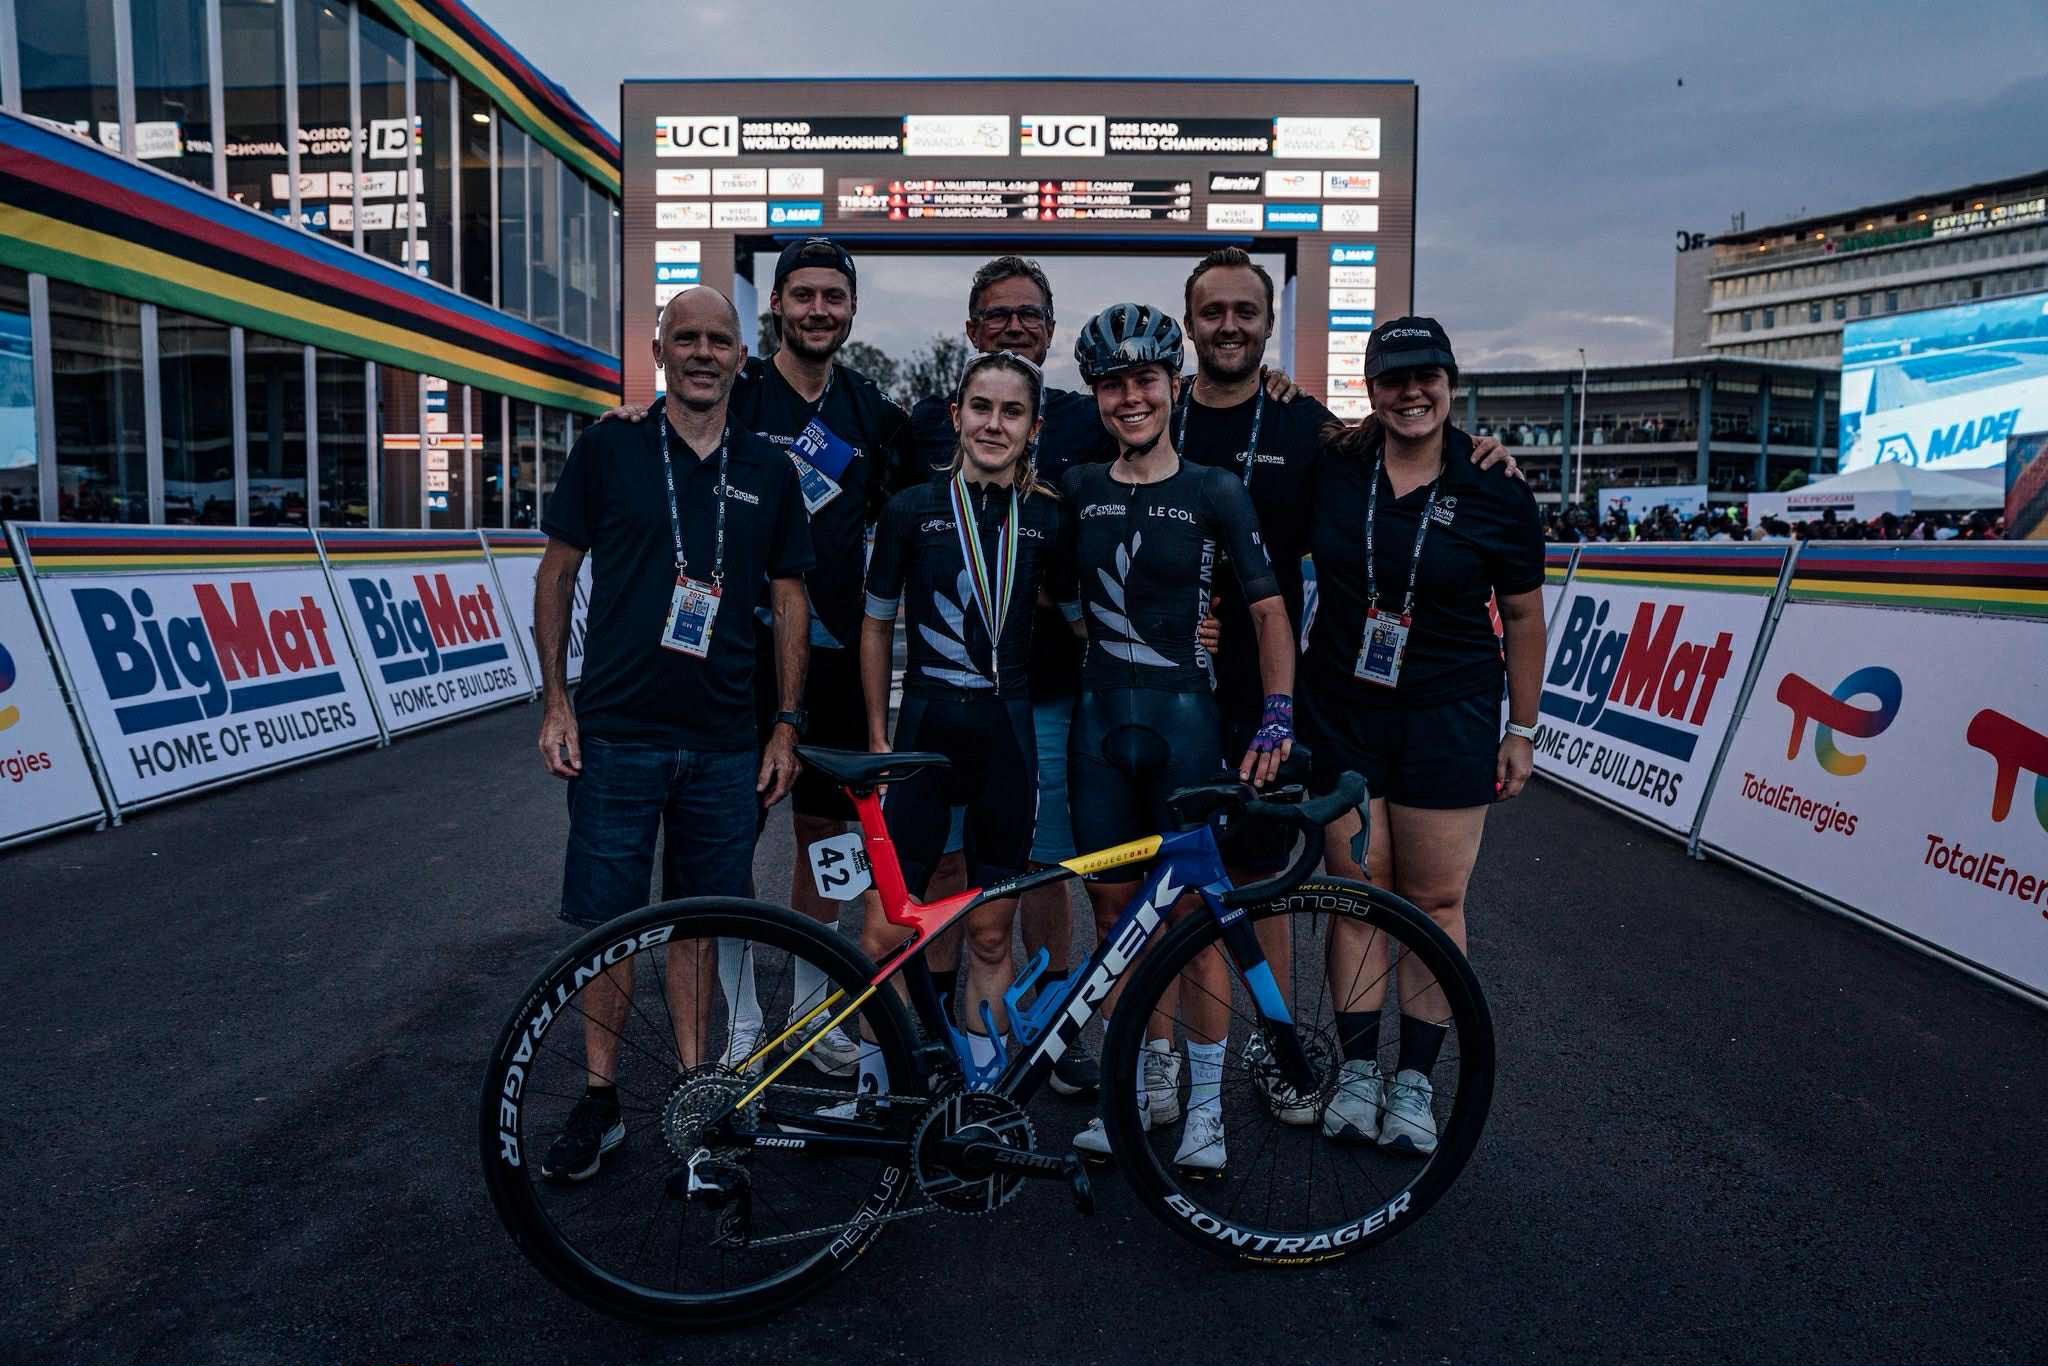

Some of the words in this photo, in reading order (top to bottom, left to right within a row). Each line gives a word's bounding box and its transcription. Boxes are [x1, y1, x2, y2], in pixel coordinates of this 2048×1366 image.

[673, 126, 730, 148] UCI
[773, 122, 810, 136] ROAD
[1038, 125, 1097, 148] UCI
[1141, 123, 1178, 137] ROAD
[743, 136, 790, 150] WORLD
[791, 136, 899, 150] CHAMPIONSHIPS
[1109, 137, 1158, 151] WORLD
[1159, 137, 1268, 152] CHAMPIONSHIPS
[1331, 176, 1372, 188] BigMat
[838, 195, 889, 208] TISSOT
[1933, 210, 1988, 230] CRYSTAL
[1990, 199, 2046, 221] LOUNGE
[1925, 406, 2023, 463] MAPEI
[1097, 504, 1126, 512] CYCLING
[1148, 506, 1166, 517] LE
[1167, 508, 1197, 525] COL
[1018, 528, 1046, 540] COL
[1200, 539, 1216, 583] NEW
[689, 590, 705, 601] 2025
[348, 573, 502, 676] BigMat
[71, 582, 336, 717] BigMat
[1547, 595, 1733, 727] BigMat
[389, 685, 438, 717] HOME
[436, 680, 457, 704] OF
[456, 667, 518, 699] BUILDERS
[129, 731, 217, 779] HOME
[219, 723, 254, 757] OF
[258, 702, 357, 747] BUILDERS
[1533, 724, 1570, 760] OME
[1567, 737, 1594, 768] OF
[1589, 746, 1683, 807] BUILDERS
[1742, 773, 1858, 836] TotalEnergies
[818, 847, 850, 892] 42
[983, 883, 1017, 897] FISHER-BLACK
[1272, 896, 1370, 917] AEOLUS
[1030, 864, 1186, 1066] TREK
[500, 924, 675, 1167] BONTRAGER
[754, 1136, 806, 1149] SRAM
[994, 1149, 1063, 1169] SRAM
[830, 1166, 900, 1260] AEOLUS
[1164, 1191, 1412, 1254] BONTRAGER
